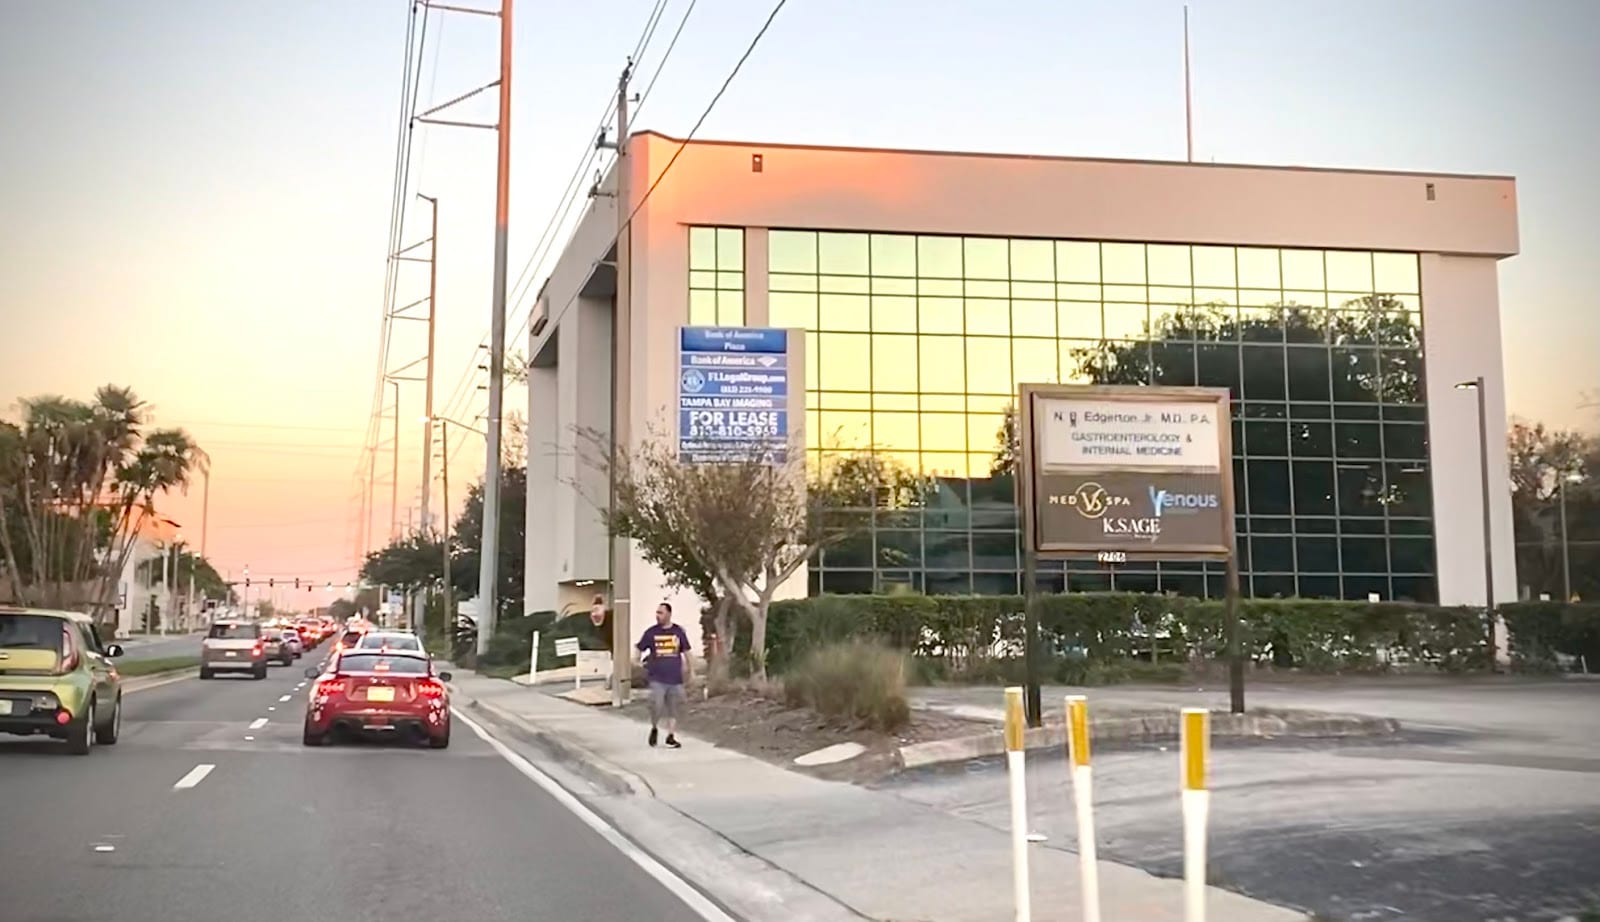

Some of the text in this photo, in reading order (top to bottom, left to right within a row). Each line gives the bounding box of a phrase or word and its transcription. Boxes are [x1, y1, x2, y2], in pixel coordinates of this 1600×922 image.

[690, 355, 755, 366] Bank of America
[680, 398, 773, 408] TAMPA BAY IMAGING
[690, 411, 778, 426] FOR LEASE
[1084, 411, 1137, 424] Edgerton
[1071, 432, 1192, 443] GASTROENTEROLOGY &
[1082, 446, 1183, 456] INTERNAL MEDICINE
[1050, 495, 1077, 505] MED
[1106, 496, 1130, 506] SPA
